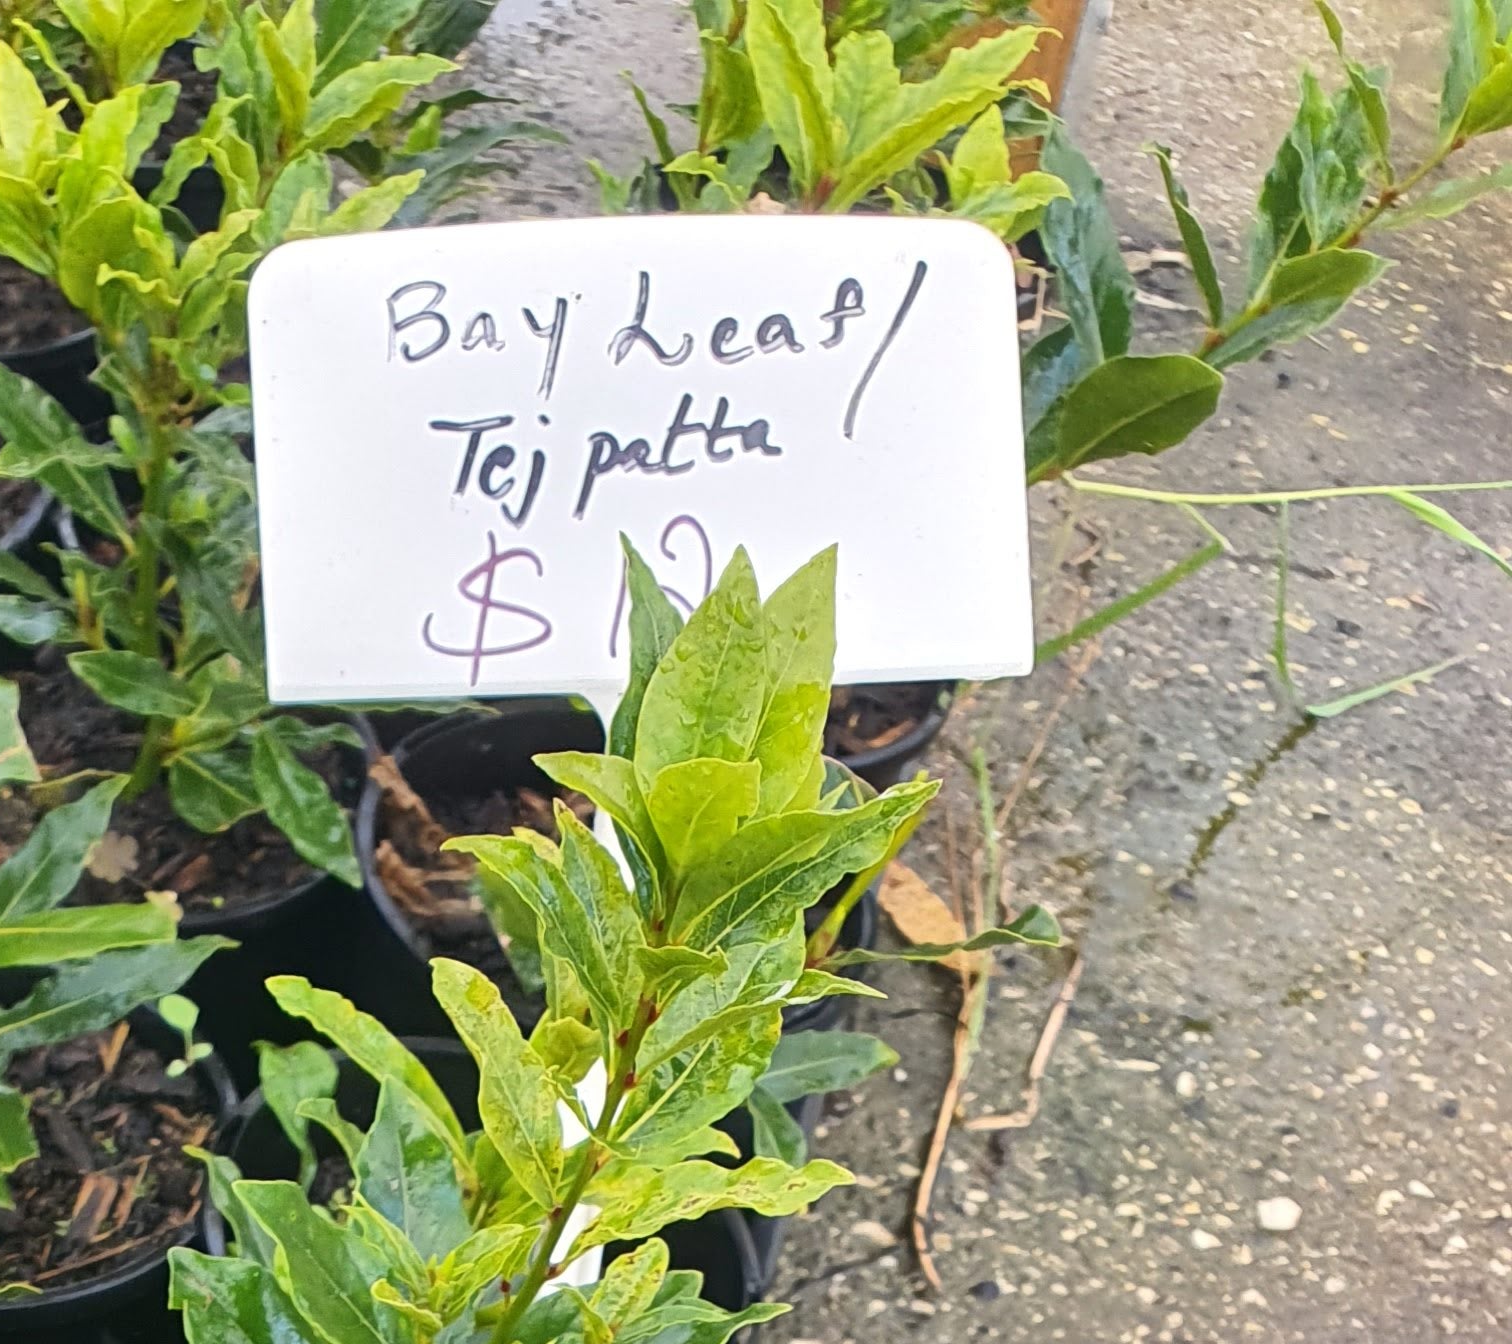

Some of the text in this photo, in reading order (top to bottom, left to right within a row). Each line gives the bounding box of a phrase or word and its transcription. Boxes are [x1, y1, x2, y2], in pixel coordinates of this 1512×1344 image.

[386, 280, 568, 399] Bay
[429, 393, 784, 527] Tej patta
